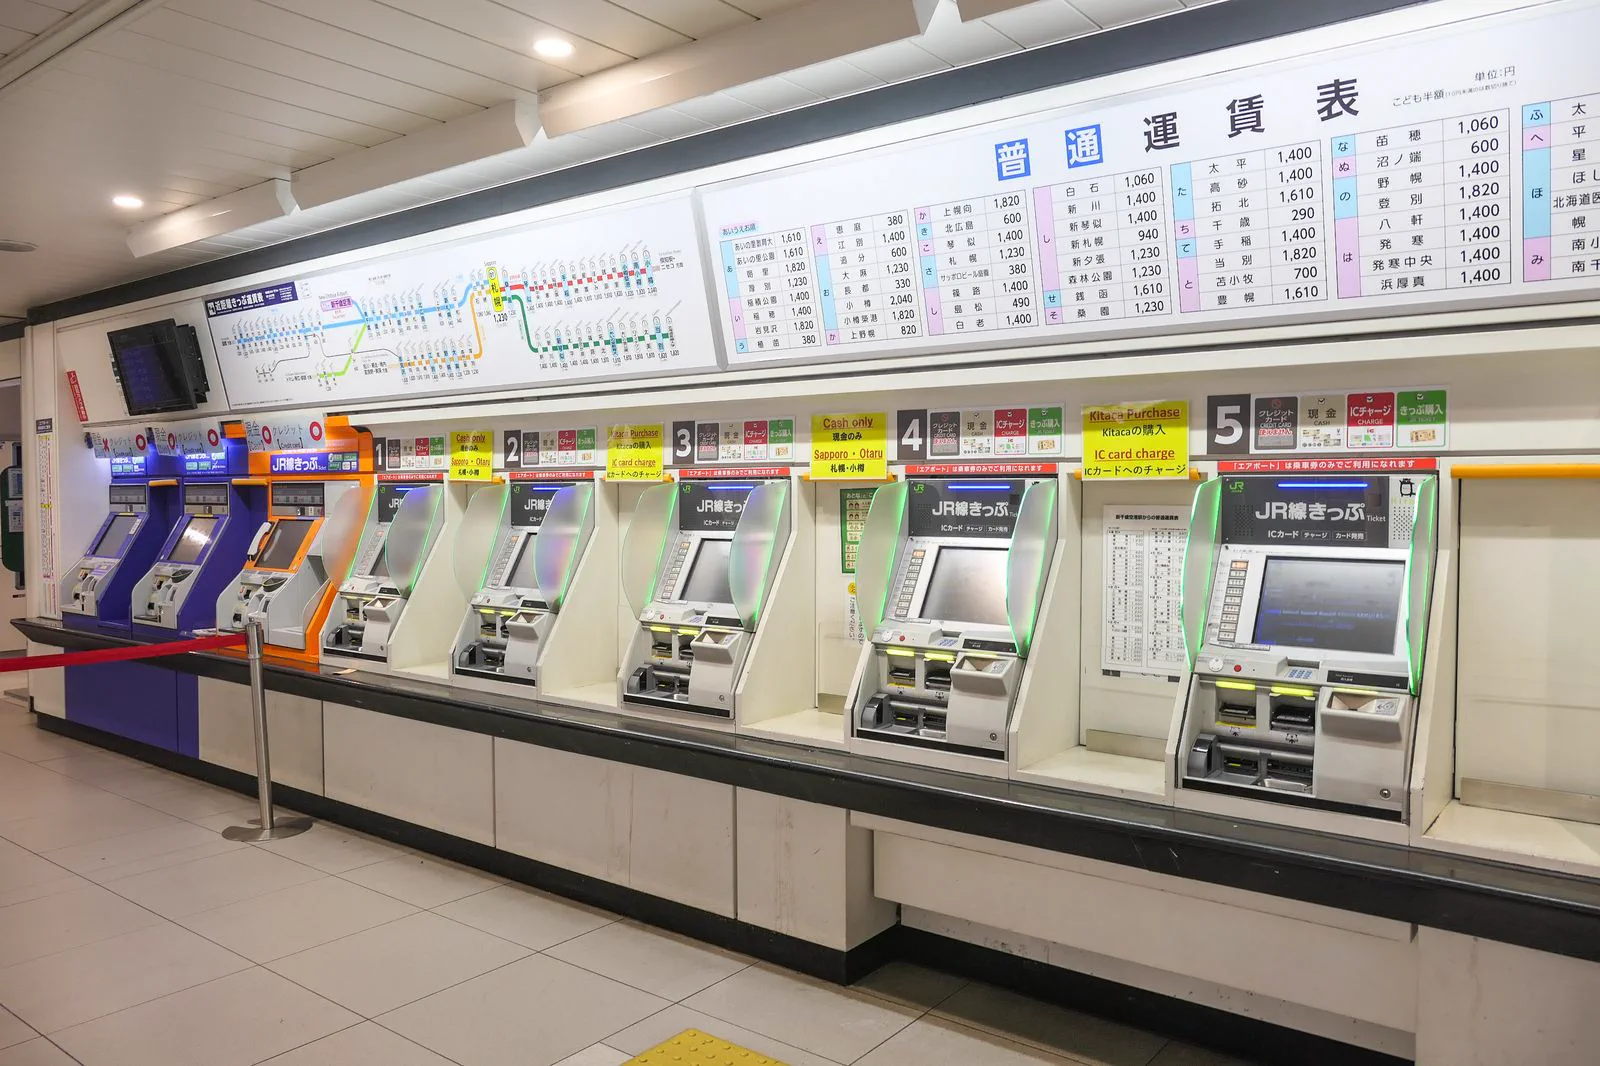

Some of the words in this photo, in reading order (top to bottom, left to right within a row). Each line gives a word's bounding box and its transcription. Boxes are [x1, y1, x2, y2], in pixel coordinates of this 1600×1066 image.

[1530, 110, 1543, 120] ふ
[1377, 130, 1421, 147] 苗穂
[1459, 116, 1498, 134] 1,060
[1338, 142, 1348, 152] な
[1377, 151, 1421, 168] 沼ノ端
[1471, 138, 1498, 153] 600
[1209, 158, 1246, 174] 太平
[1278, 147, 1311, 163] 1,400
[1339, 162, 1349, 171] ぬ
[1210, 178, 1248, 193] 高砂
[1279, 167, 1312, 183] 1,400
[1378, 172, 1422, 188] 野幌
[1460, 160, 1499, 177] 1,400
[1066, 183, 1098, 197] 白石
[1125, 173, 1154, 187] 1,060
[1178, 188, 1186, 196] た
[1340, 192, 1350, 200] の
[1379, 193, 1422, 209] 登別
[1460, 182, 1499, 199] 1,820
[1532, 188, 1543, 198] ほ
[994, 195, 1019, 208] 1,820
[1068, 201, 1100, 214] 新川
[1127, 192, 1156, 206] 1,400
[1212, 198, 1249, 212] 拓北
[1280, 187, 1313, 203] 1,610
[888, 215, 902, 226] 380
[1004, 213, 1021, 224] 600
[1070, 219, 1102, 231] 新琴似
[1128, 210, 1157, 224] 1,400
[1213, 217, 1250, 230] 千歳
[1292, 207, 1314, 220] 290
[1380, 214, 1422, 230] 八軒
[1460, 204, 1499, 220] 1,400
[1180, 225, 1189, 234] ち
[782, 232, 801, 243] 1,610
[883, 231, 905, 243] 1,400
[998, 230, 1023, 242] 1,400
[1071, 237, 1103, 249] 新札幌
[1138, 229, 1158, 241] 940
[1214, 236, 1251, 249] 手稲
[1282, 227, 1315, 242] 1,400
[1380, 235, 1423, 250] 発寒
[1461, 226, 1499, 242] 1,400
[784, 247, 803, 258] 1,610
[892, 247, 906, 257] 600
[1000, 247, 1024, 259] 1,230
[1182, 244, 1190, 252] て
[1073, 254, 1104, 266] 新夕張
[1131, 247, 1160, 260] 1,230
[1215, 254, 1252, 268] 当別
[1283, 247, 1316, 261] 1,820
[1343, 252, 1352, 262] は
[1373, 255, 1432, 271] 発寒中央
[1461, 247, 1500, 263] 1,400
[1532, 255, 1544, 264] み
[786, 262, 805, 272] 1,820
[887, 263, 908, 274] 1,230
[1009, 264, 1026, 275] 380
[1069, 271, 1112, 284] 森林公園
[1132, 265, 1161, 278] 1,230
[1216, 274, 1253, 286] 苫小牧
[1294, 266, 1317, 279] 700
[1382, 276, 1424, 290] 浜厚真
[1461, 268, 1500, 284] 1,400
[788, 277, 807, 288] 1,230
[896, 278, 910, 288] 330
[1003, 280, 1028, 292] 1,400
[1185, 280, 1192, 289] と
[790, 291, 809, 302] 1,400
[1076, 289, 1108, 301] 銭函
[1134, 283, 1162, 296] 1,610
[1218, 292, 1254, 305] 豊幌
[1285, 286, 1318, 300] 1,610
[890, 294, 912, 305] 2,040
[1013, 297, 1029, 307] 490
[792, 306, 811, 316] 1,400
[893, 310, 914, 320] 1,820
[1078, 306, 1109, 318] 桑園
[1136, 301, 1164, 314] 1,230
[794, 321, 813, 330] 1,820
[1007, 314, 1031, 325] 1,400
[901, 325, 916, 335] 820
[802, 335, 815, 344] 380
[1087, 408, 1126, 423] Kitaca
[1124, 405, 1180, 420] Purchase
[1259, 410, 1293, 419] クレジット
[1308, 408, 1336, 419] 現金
[1350, 405, 1391, 416] ICチャージ
[1400, 404, 1443, 415] きっぷ購入
[823, 416, 848, 430] Cash
[852, 416, 873, 428] only
[996, 420, 1024, 429] ICチャージ
[1215, 406, 1242, 444] 5
[273, 423, 305, 438] クレジット
[631, 429, 658, 438] Purchase
[833, 432, 862, 441] 現金のみ
[902, 419, 922, 450] 4
[1100, 424, 1167, 438] Kitacaの購入
[456, 433, 472, 445] Cash
[473, 434, 485, 443] only
[676, 430, 691, 457] 3
[376, 444, 381, 465] 1
[506, 438, 518, 461] 2
[814, 450, 850, 460] Sapporo
[860, 448, 882, 458] Otaru
[1095, 450, 1105, 459] IC
[1108, 448, 1132, 459] card
[1136, 448, 1175, 461] charge
[270, 455, 320, 473] JR線きっぷ
[618, 457, 633, 466] card
[636, 458, 656, 468] charge
[831, 464, 864, 472] 札幌・小樽
[1085, 464, 1185, 476] ICカードへのチャージ
[932, 501, 1008, 516] JR線きっぷ
[1256, 502, 1365, 521] JR線きっぷ
